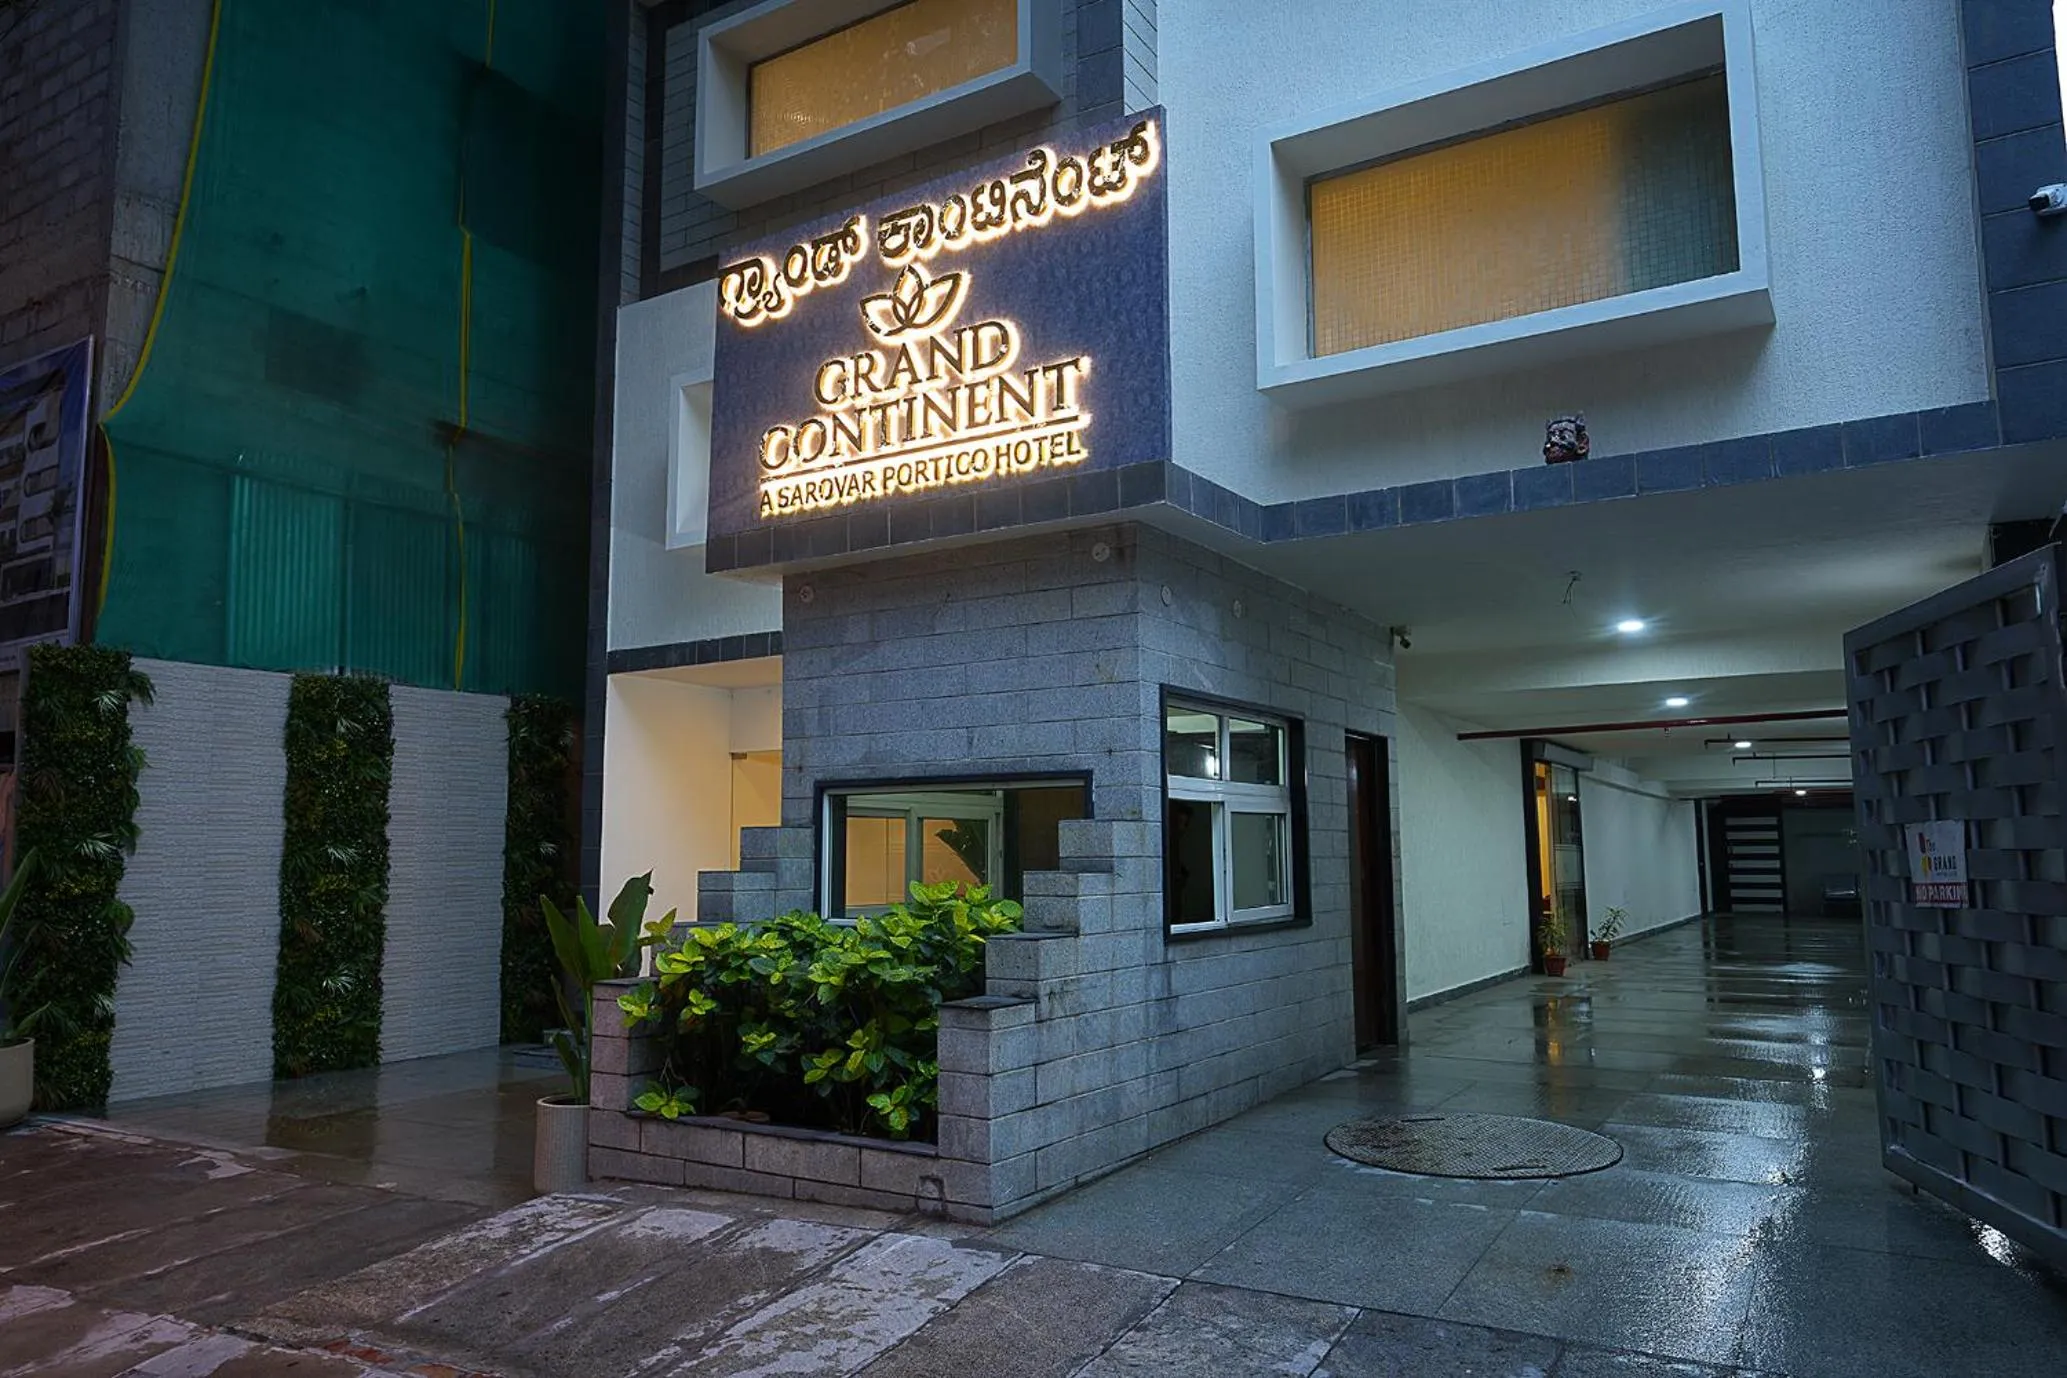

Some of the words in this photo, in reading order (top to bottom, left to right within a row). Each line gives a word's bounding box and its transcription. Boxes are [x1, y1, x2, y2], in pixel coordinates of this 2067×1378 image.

[876, 119, 1150, 259] ಕಾಂಟಿನೆಂಟ್
[814, 320, 1010, 405] GRAND
[759, 357, 1082, 470] CONTINENT
[759, 489, 773, 512] A
[777, 470, 876, 508] SAROVAR
[882, 448, 989, 490] PORTICO
[995, 430, 1081, 470] HOTEL
